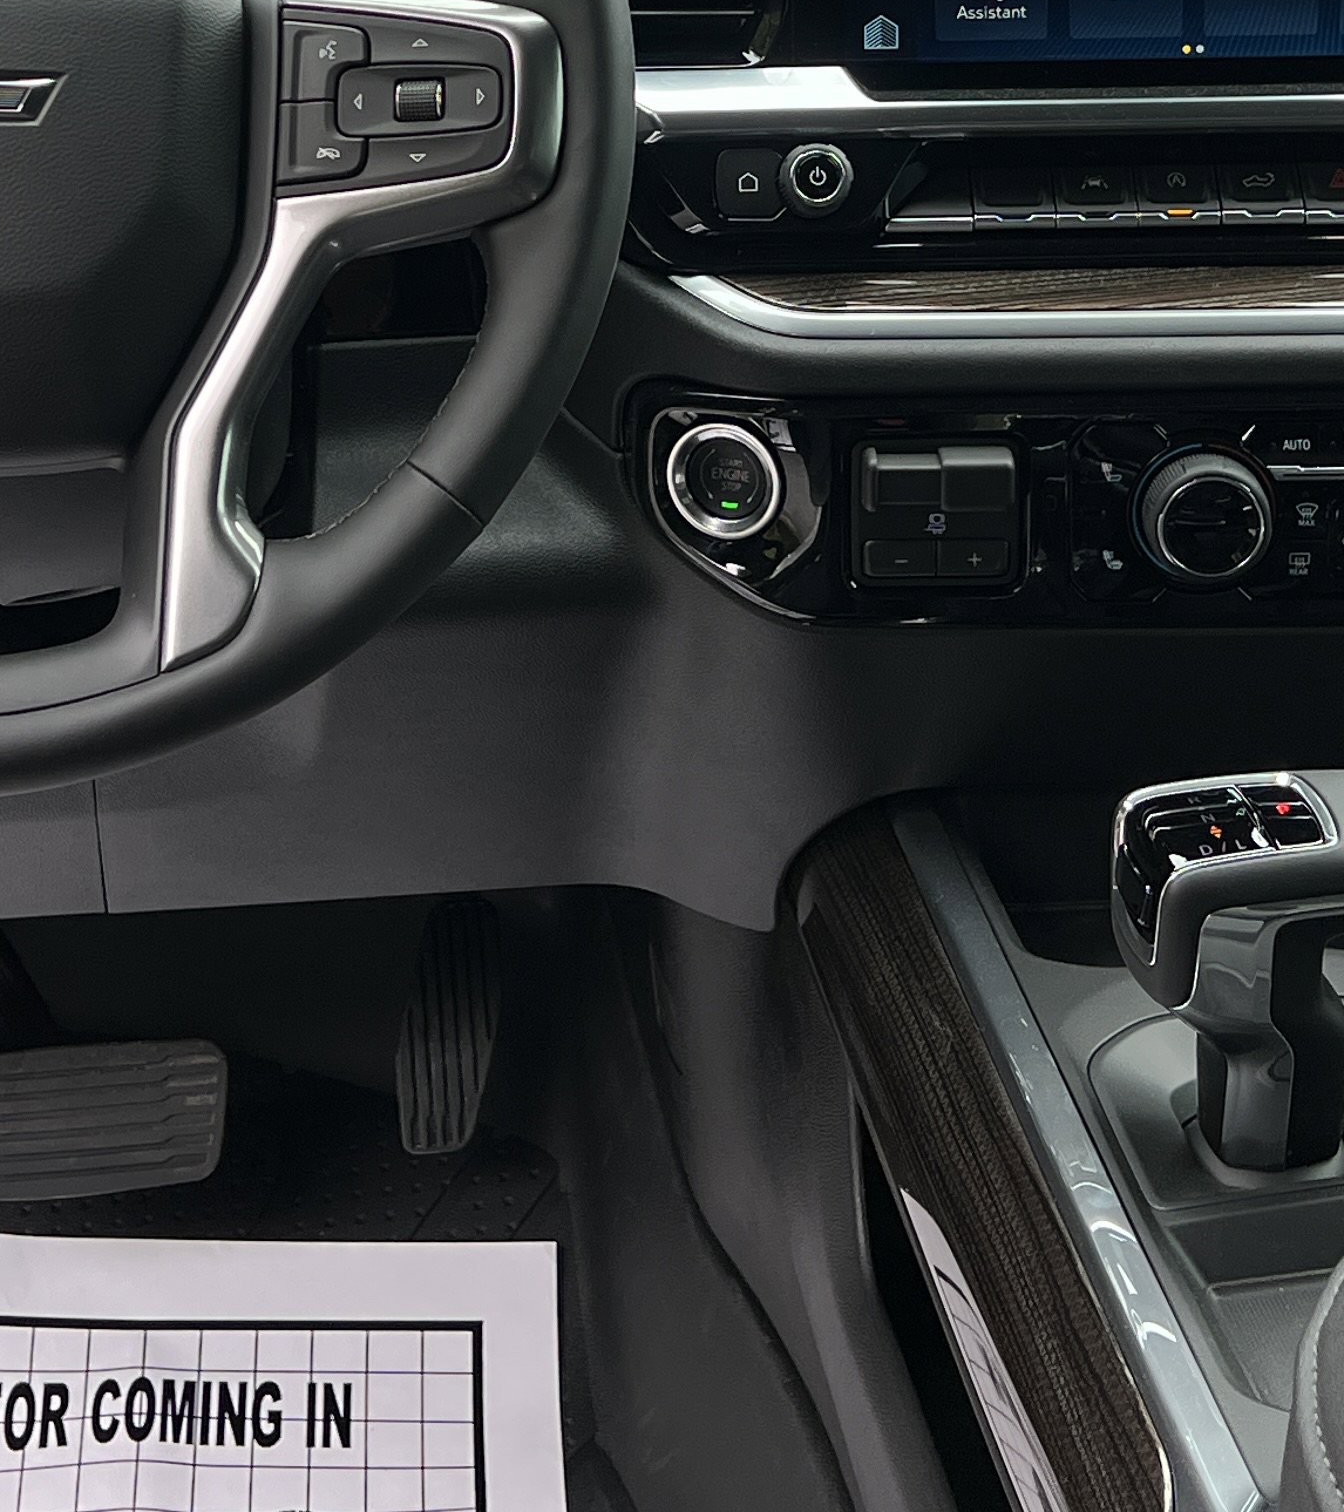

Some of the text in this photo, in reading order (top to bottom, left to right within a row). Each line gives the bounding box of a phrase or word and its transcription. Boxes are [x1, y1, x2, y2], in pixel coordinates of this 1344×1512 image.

[957, 5, 1027, 20] Assistant
[1282, 439, 1311, 451] AUTO
[91, 1376, 282, 1448] COMING
[306, 1381, 353, 1448] IN
